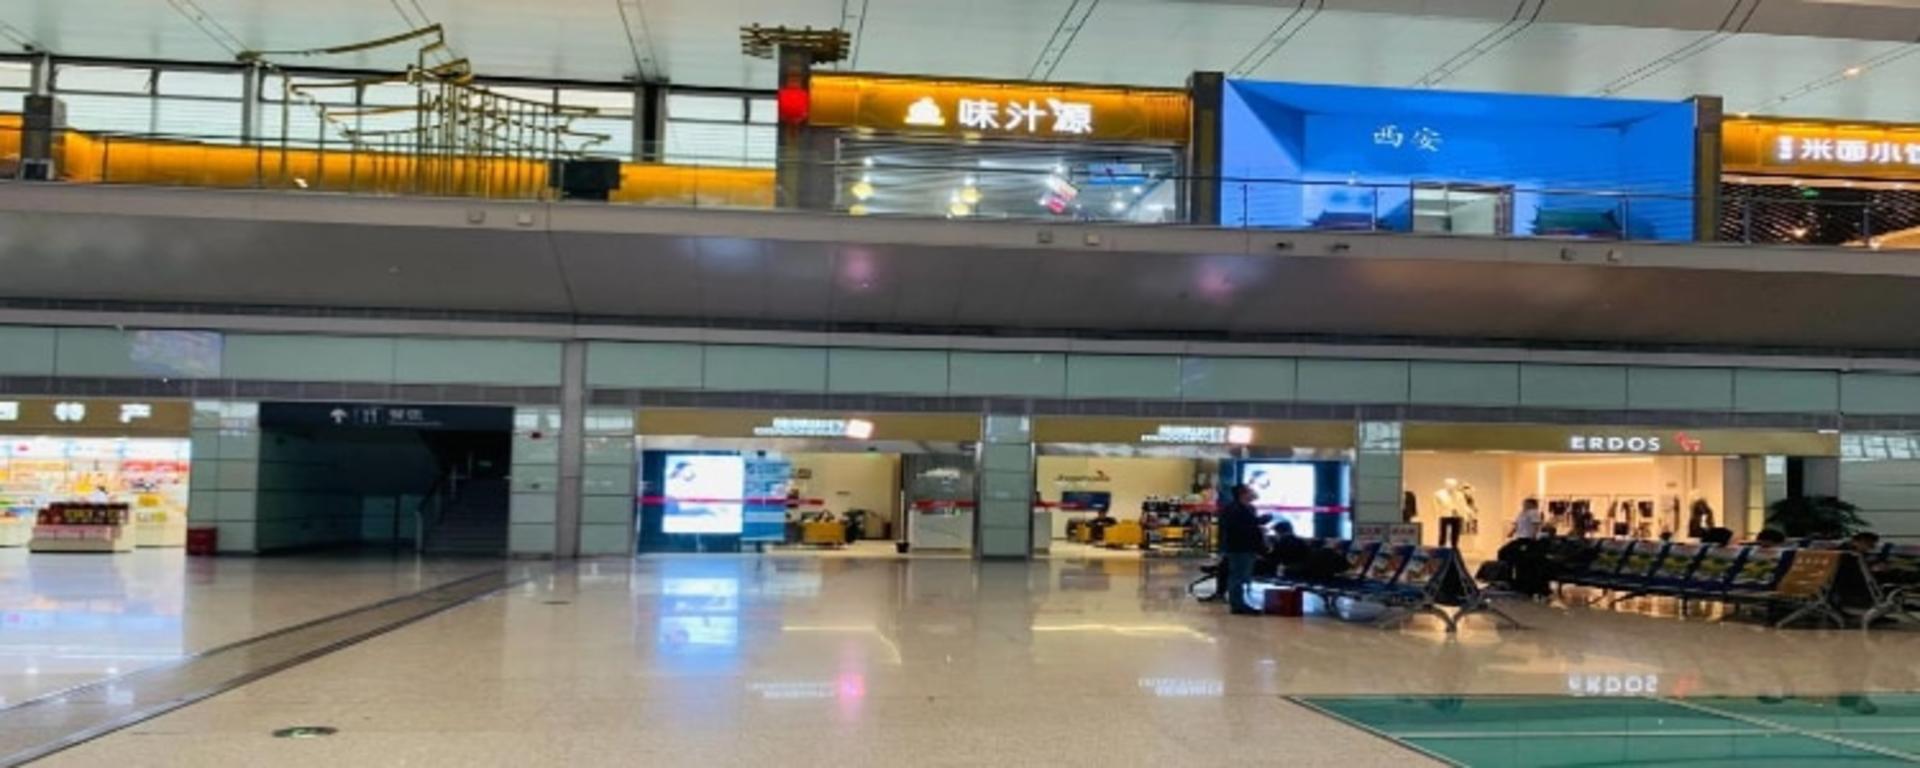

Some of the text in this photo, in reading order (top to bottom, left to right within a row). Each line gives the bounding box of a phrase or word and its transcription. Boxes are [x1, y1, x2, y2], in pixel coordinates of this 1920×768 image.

[958, 97, 1092, 134] 味汁源
[1372, 123, 1444, 153] 西安
[1570, 436, 1661, 452] ERDOS
